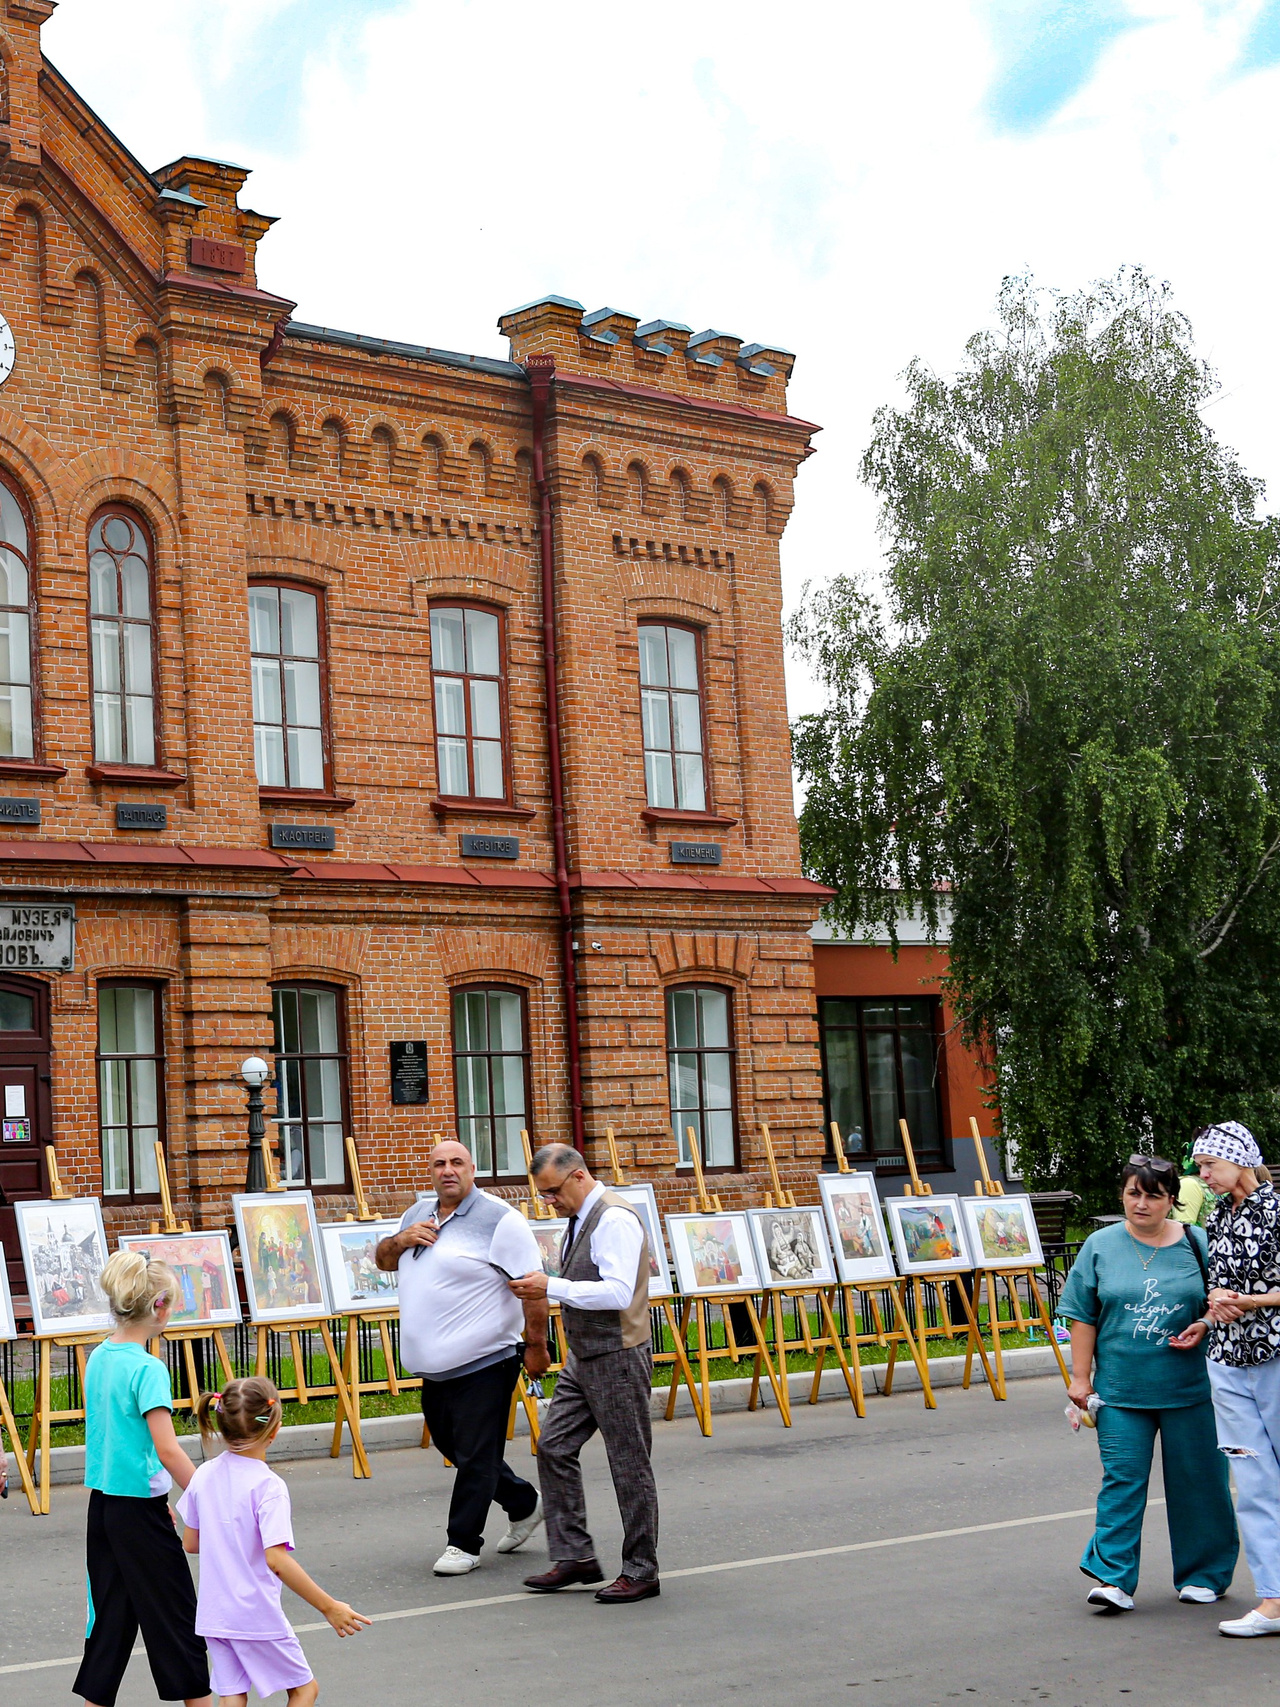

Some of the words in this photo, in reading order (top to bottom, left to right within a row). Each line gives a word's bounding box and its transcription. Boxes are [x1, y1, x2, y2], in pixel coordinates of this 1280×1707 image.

[202, 247, 235, 267] 1887
[11, 909, 62, 926] МУЗЕЯ
[1140, 1278, 1162, 1307] Be
